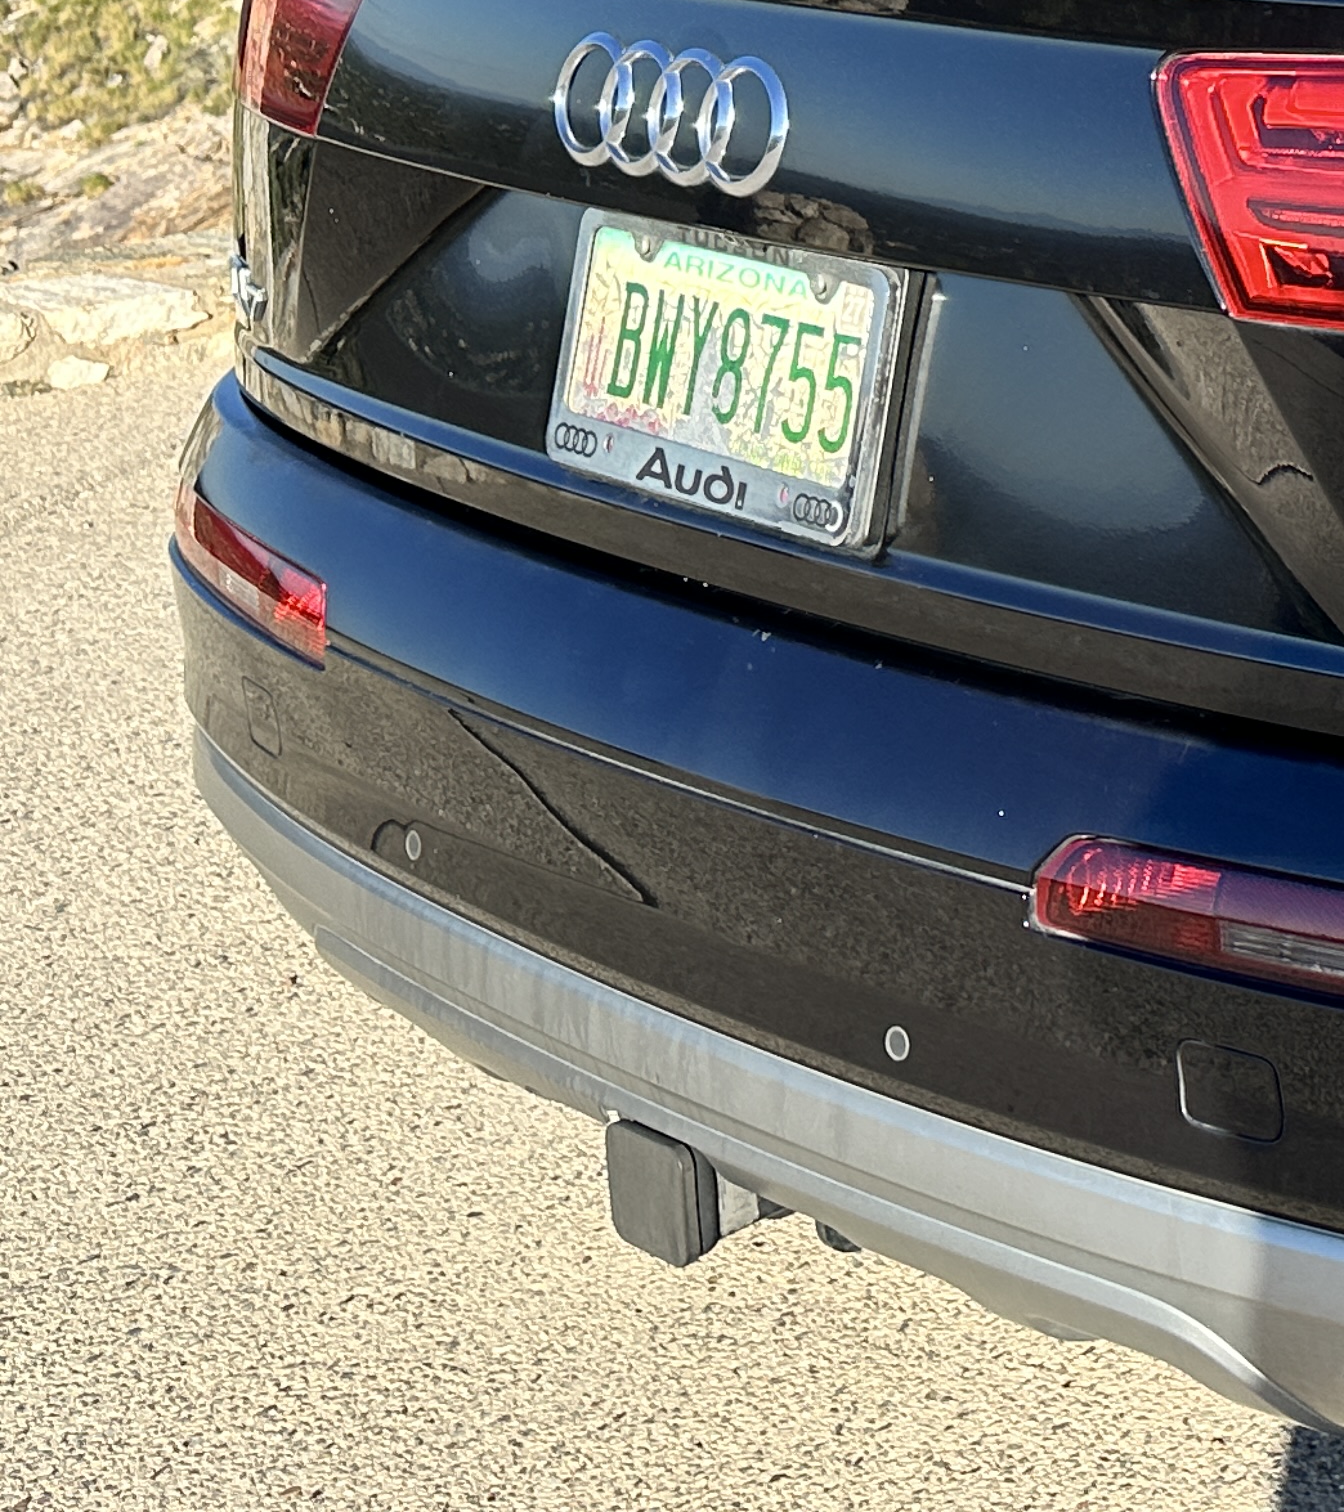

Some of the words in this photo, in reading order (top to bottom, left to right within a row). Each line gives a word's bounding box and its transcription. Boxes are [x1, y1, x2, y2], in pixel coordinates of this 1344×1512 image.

[663, 251, 809, 298] ARIZONA
[606, 282, 863, 453] BWY8755
[635, 447, 748, 510] Audi
